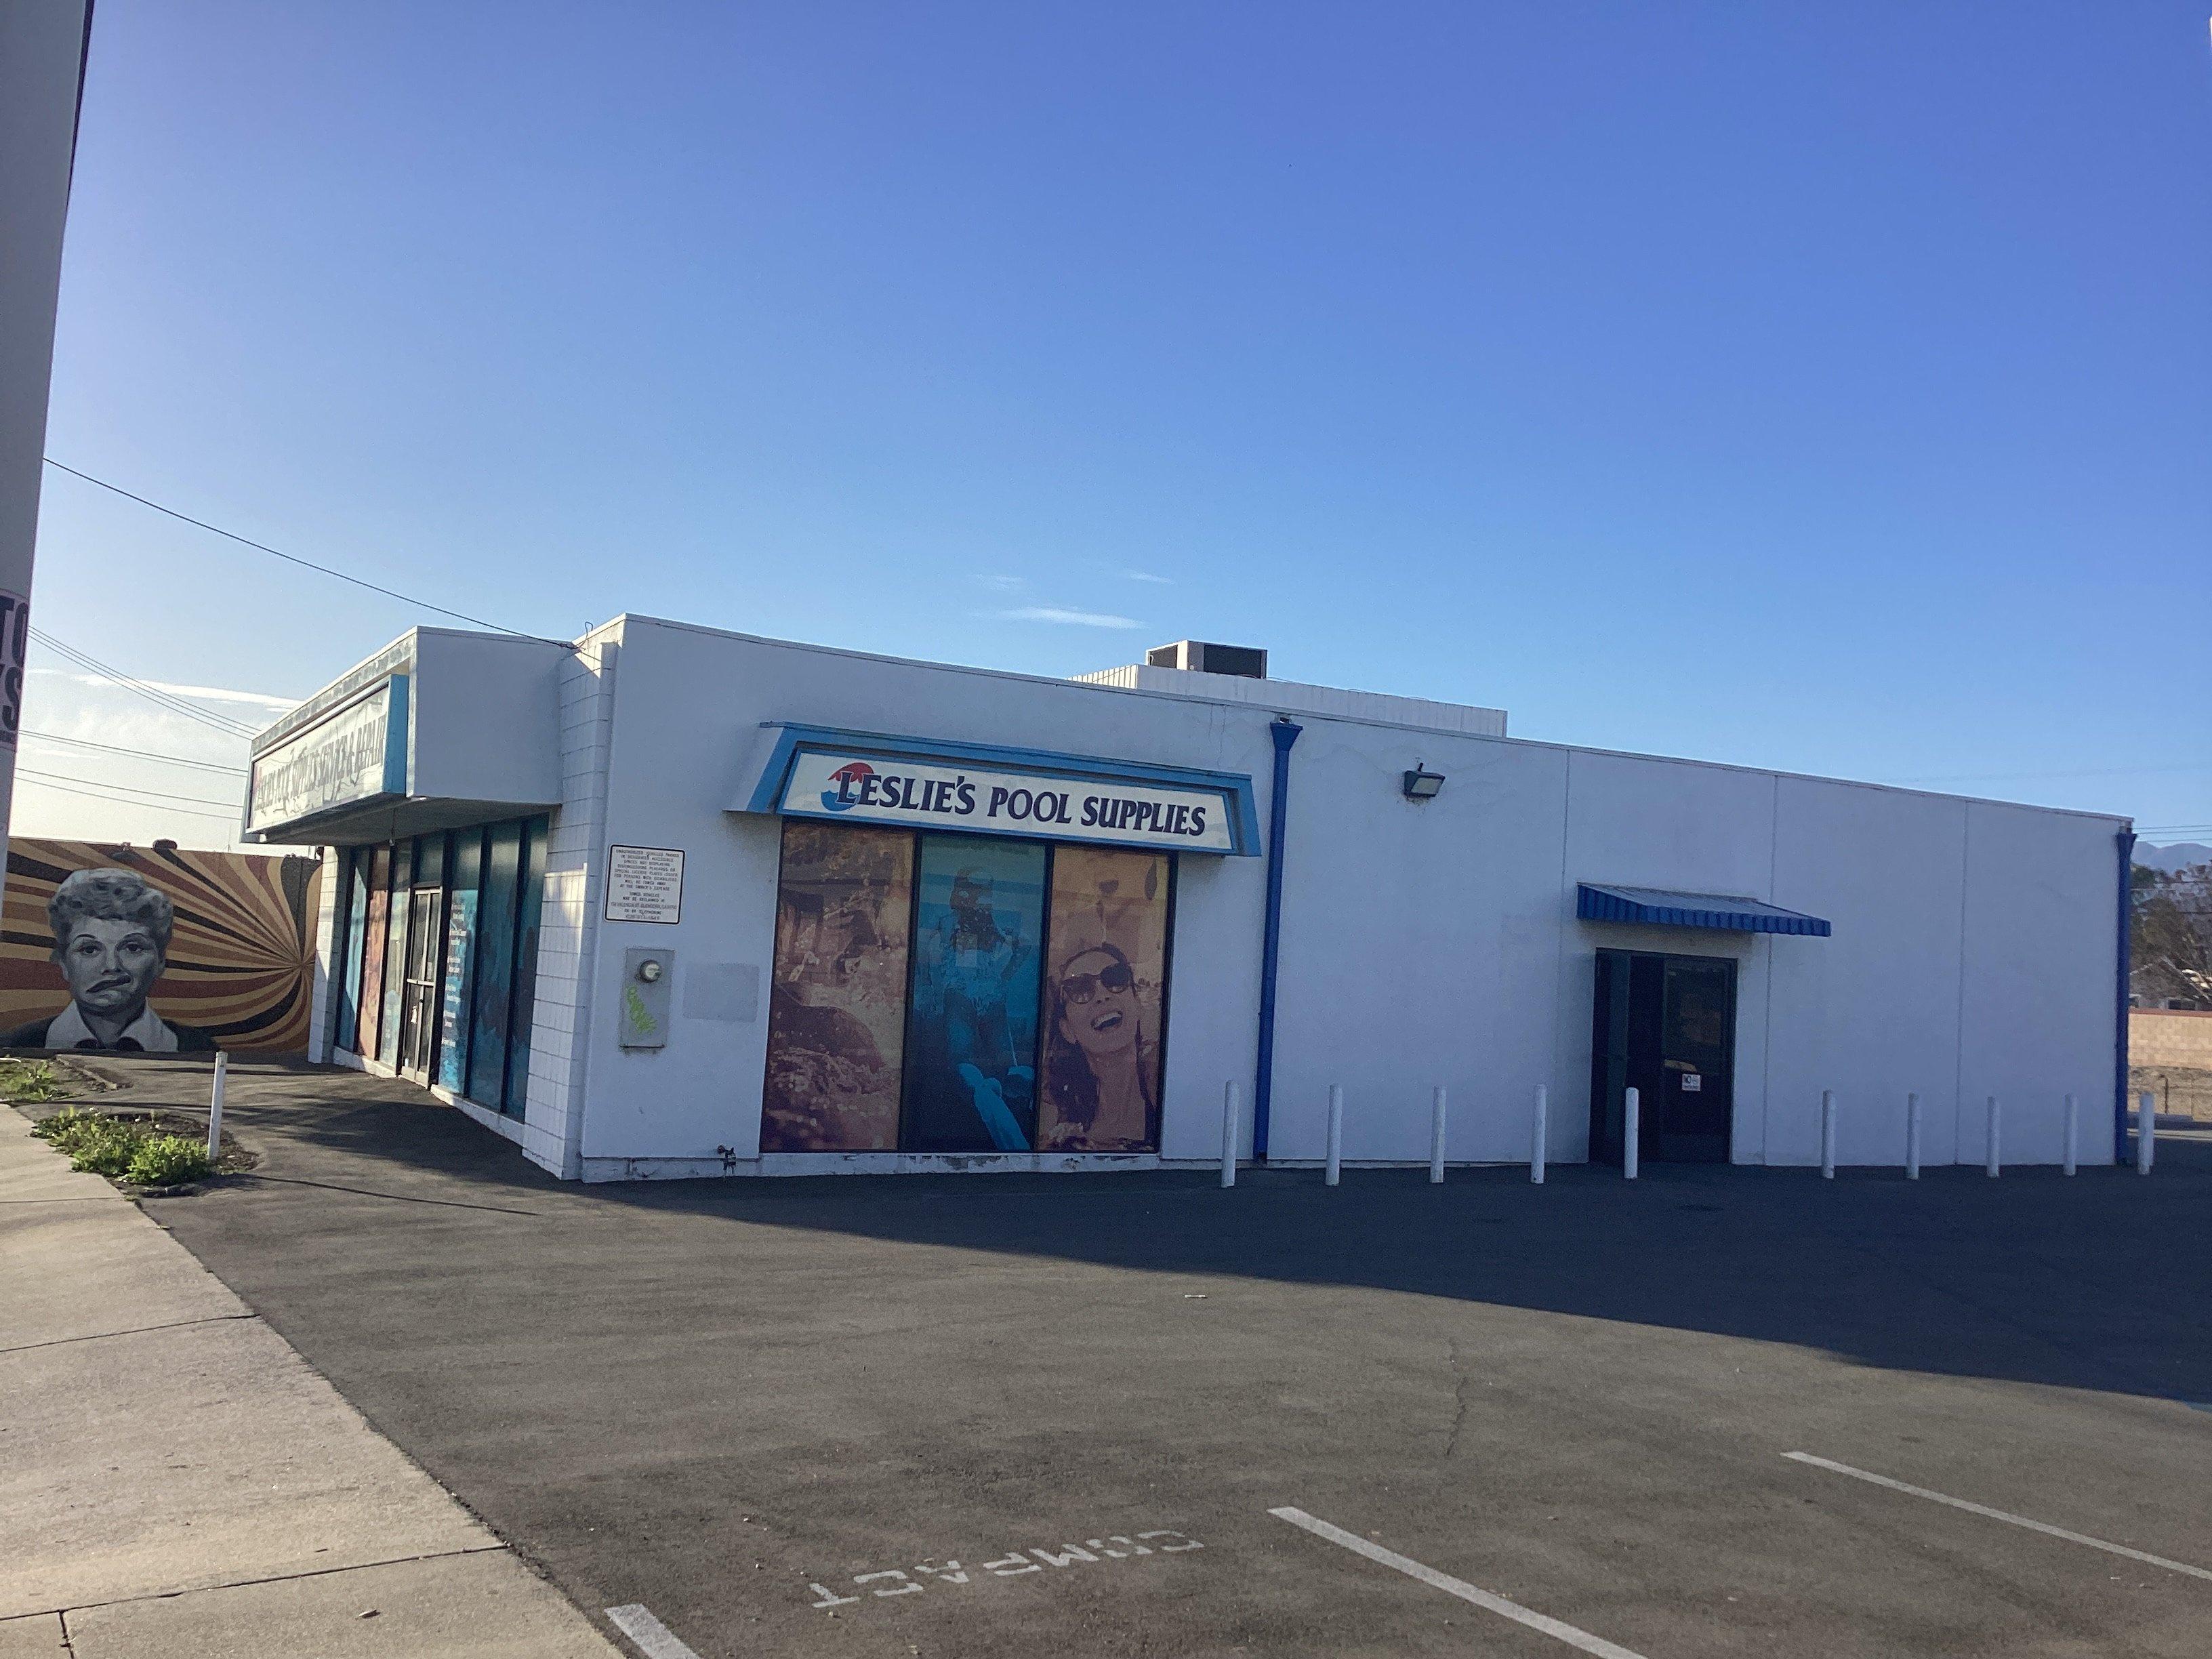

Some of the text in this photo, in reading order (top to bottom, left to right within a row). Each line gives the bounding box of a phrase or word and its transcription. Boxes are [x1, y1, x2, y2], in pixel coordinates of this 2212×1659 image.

[836, 775, 1206, 836] LESLIE'S POOL SUPPLIES
[812, 1529, 1206, 1609] COMPACT
